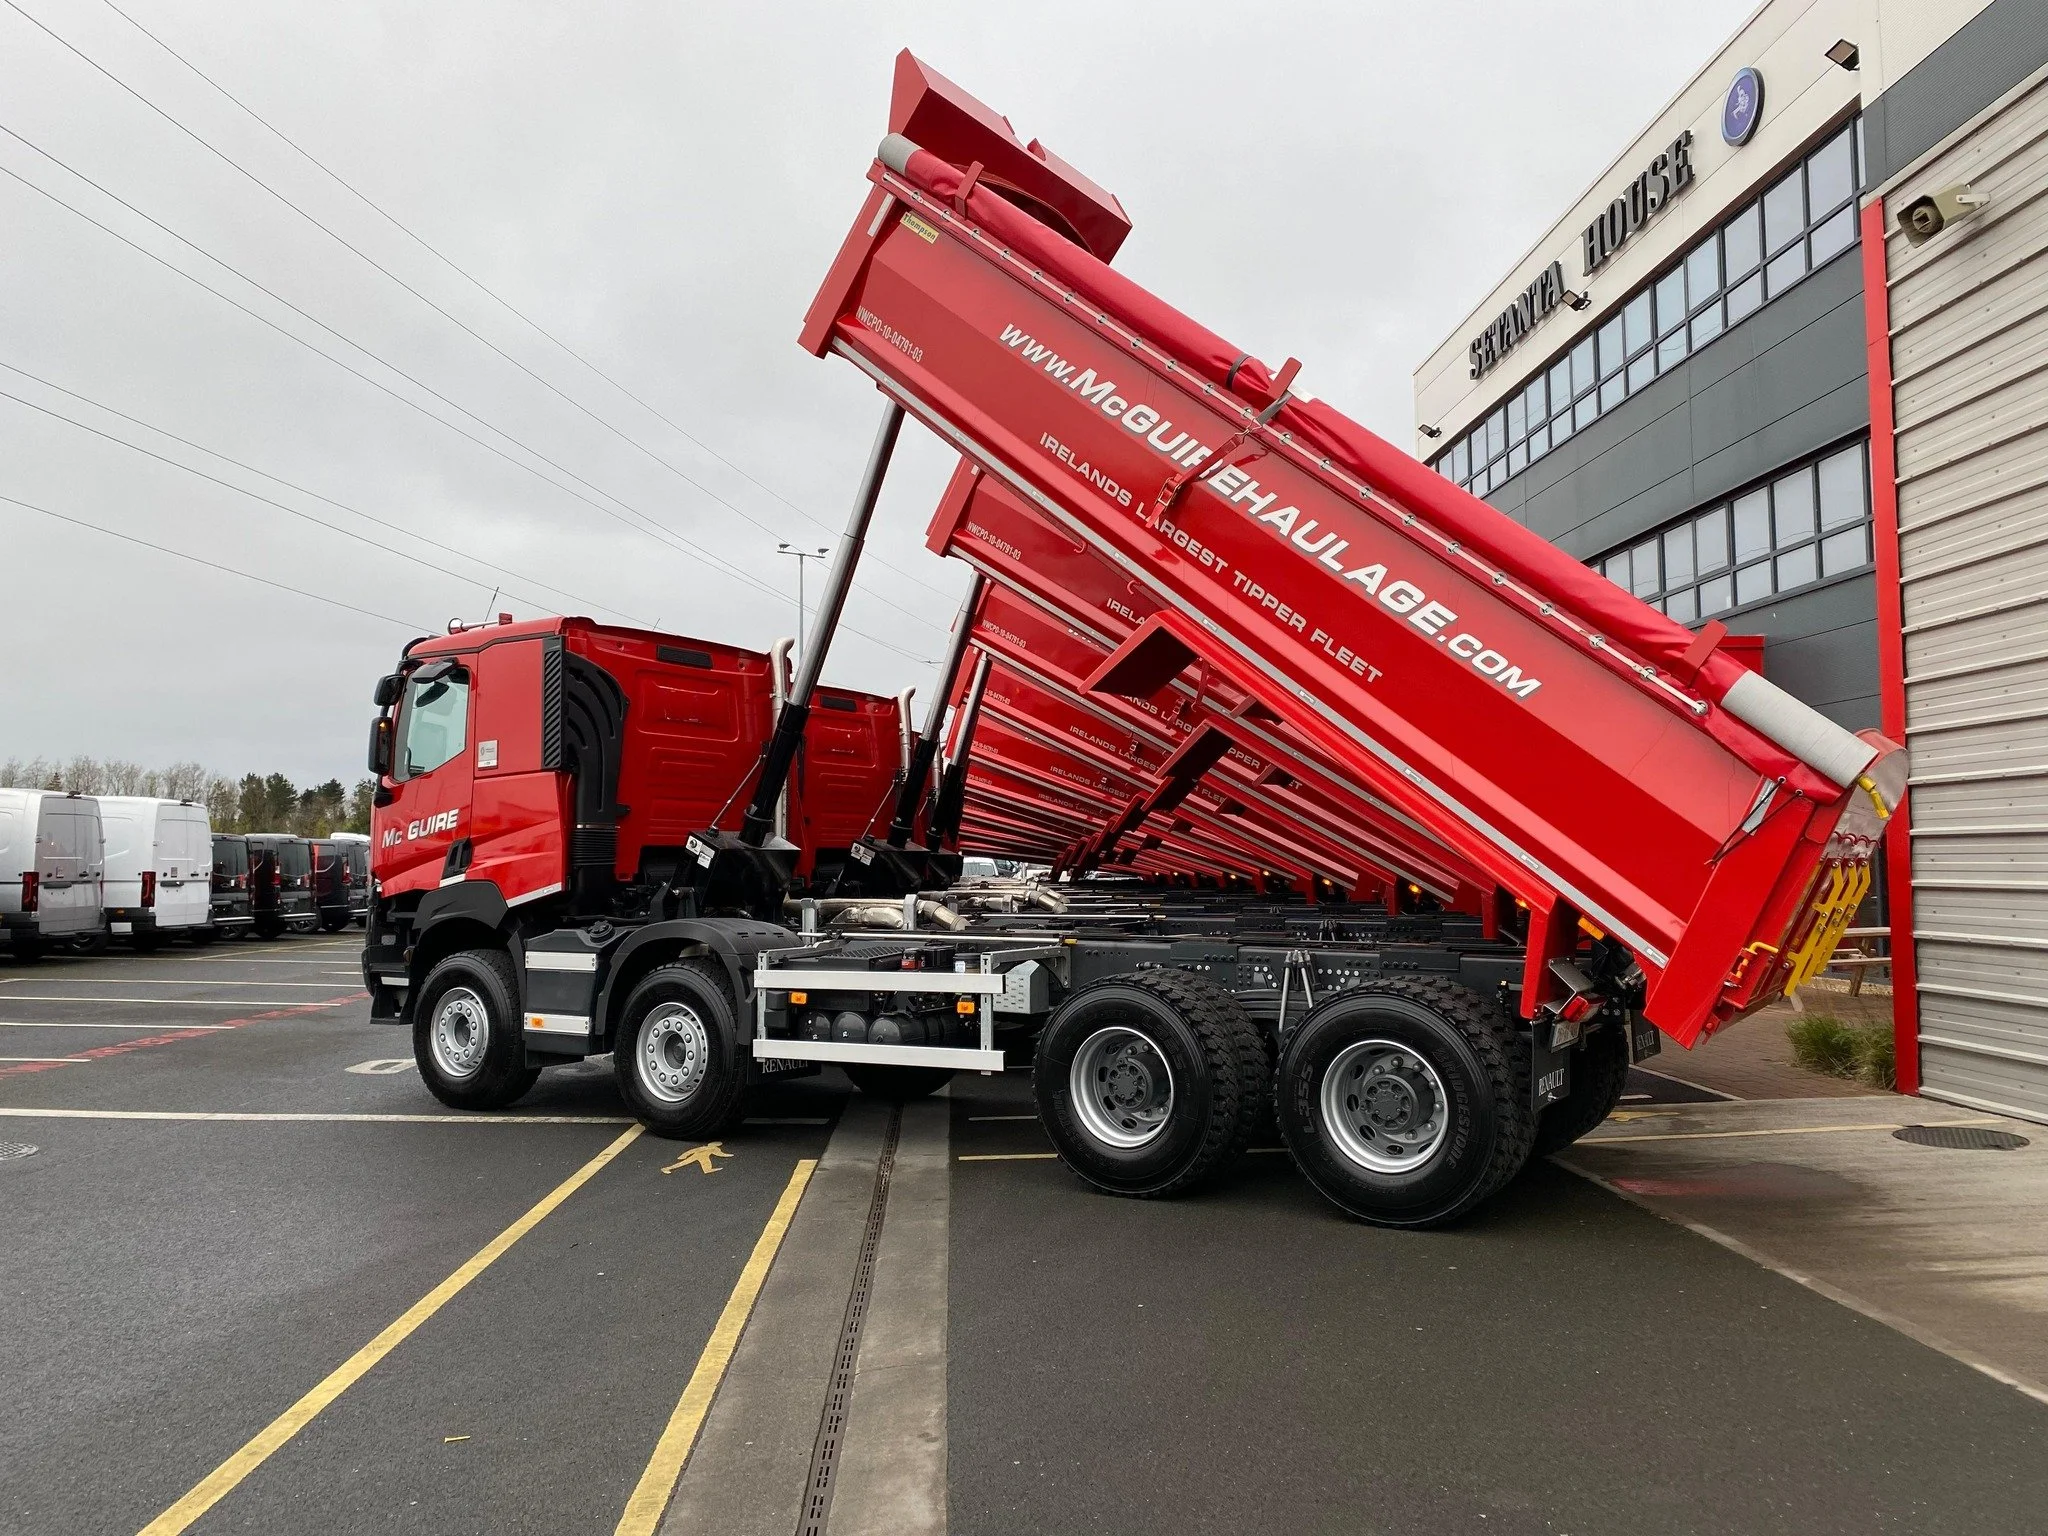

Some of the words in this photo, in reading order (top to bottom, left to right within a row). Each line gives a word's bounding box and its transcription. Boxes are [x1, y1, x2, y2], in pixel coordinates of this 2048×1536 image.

[902, 213, 937, 241] Thompson
[1469, 261, 1566, 380] SETANTA
[1581, 130, 1695, 277] HOUSE
[1039, 431, 1133, 507] IRELANDS
[1233, 569, 1307, 633] TIPPER
[1309, 628, 1383, 685] FLEET
[1106, 597, 1146, 625] IRELA
[1069, 725, 1116, 752] IRELANDS
[1049, 765, 1091, 785] IRELANDS
[381, 827, 403, 849] Mc
[407, 808, 459, 841] GUIRE
[1538, 1068, 1564, 1096] RENAULT
